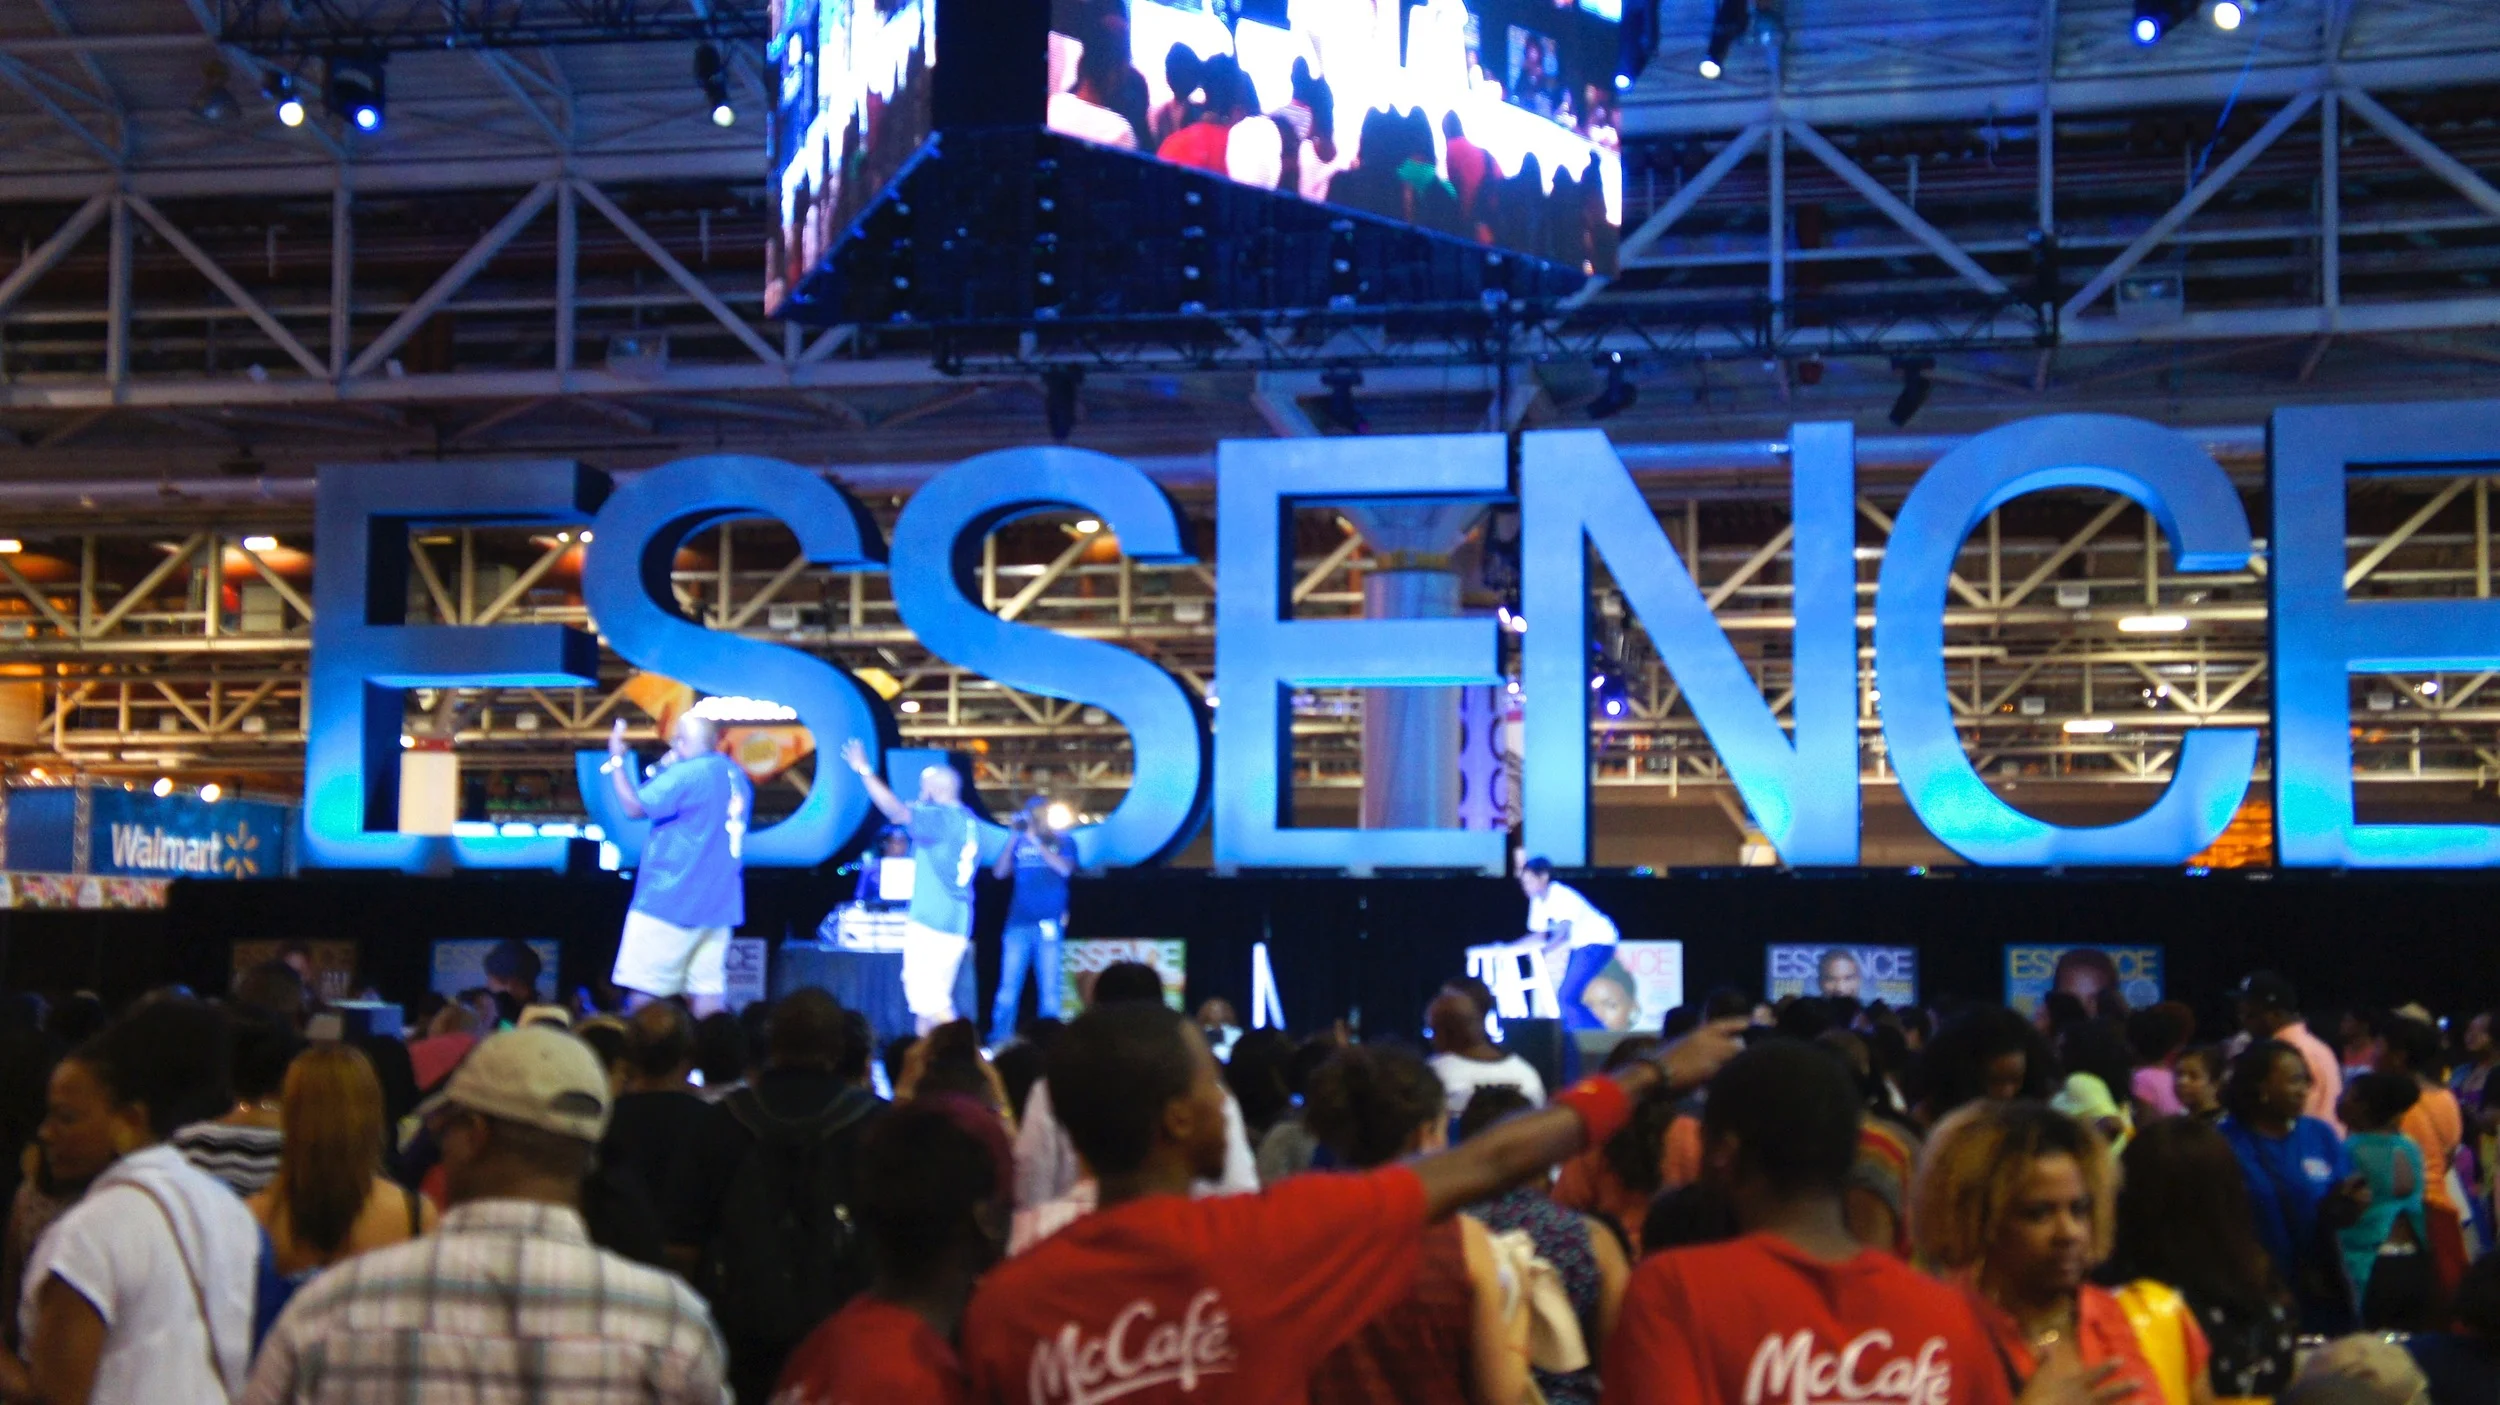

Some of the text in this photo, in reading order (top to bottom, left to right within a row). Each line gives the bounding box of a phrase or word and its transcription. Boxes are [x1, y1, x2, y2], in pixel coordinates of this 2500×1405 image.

[305, 404, 2500, 867] ESSENCE
[111, 822, 224, 874] Walmart
[1028, 1289, 1238, 1405] McCafé
[1743, 1331, 1951, 1405] McCafé
